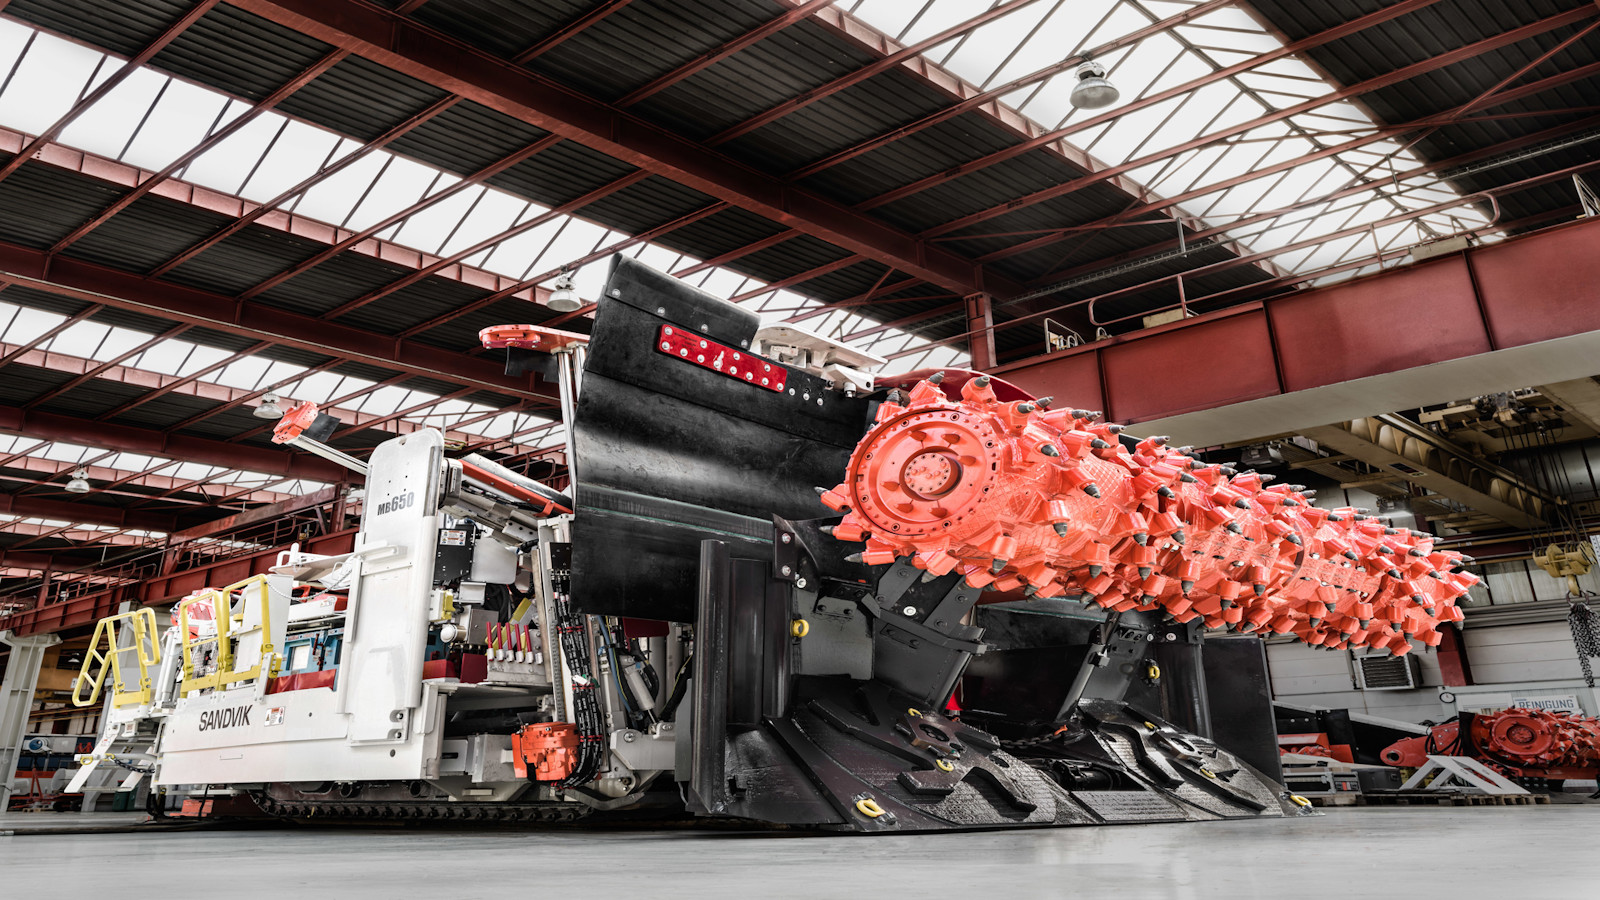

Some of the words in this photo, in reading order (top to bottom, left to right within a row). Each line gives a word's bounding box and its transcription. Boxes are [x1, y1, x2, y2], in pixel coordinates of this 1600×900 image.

[377, 492, 415, 515] MB650
[1519, 699, 1574, 709] REINIGUNG
[199, 704, 253, 731] SANDVIK
